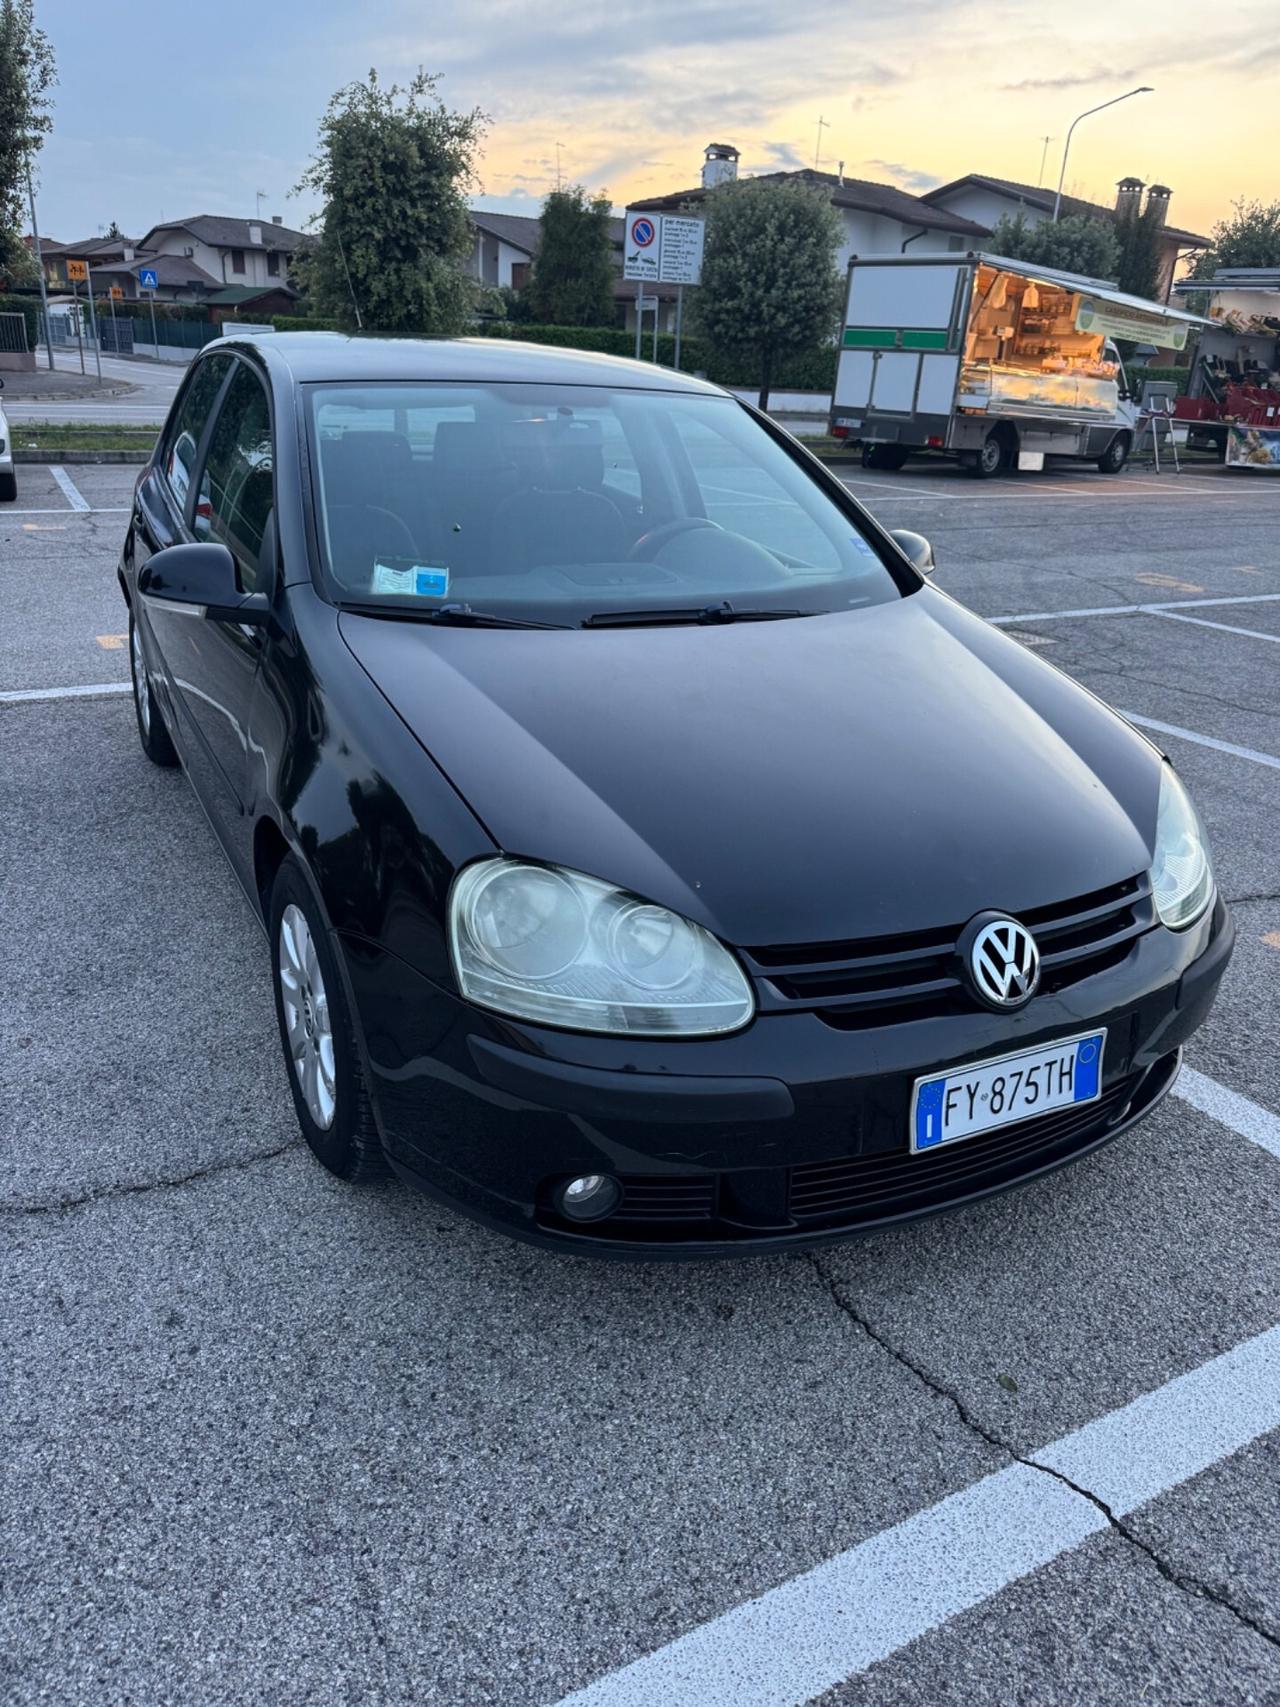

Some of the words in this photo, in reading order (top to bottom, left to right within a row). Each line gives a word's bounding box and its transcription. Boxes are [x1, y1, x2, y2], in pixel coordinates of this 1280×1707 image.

[972, 920, 1040, 1006] VW
[944, 1081, 980, 1126] FY
[990, 1054, 1075, 1115] 875TH
